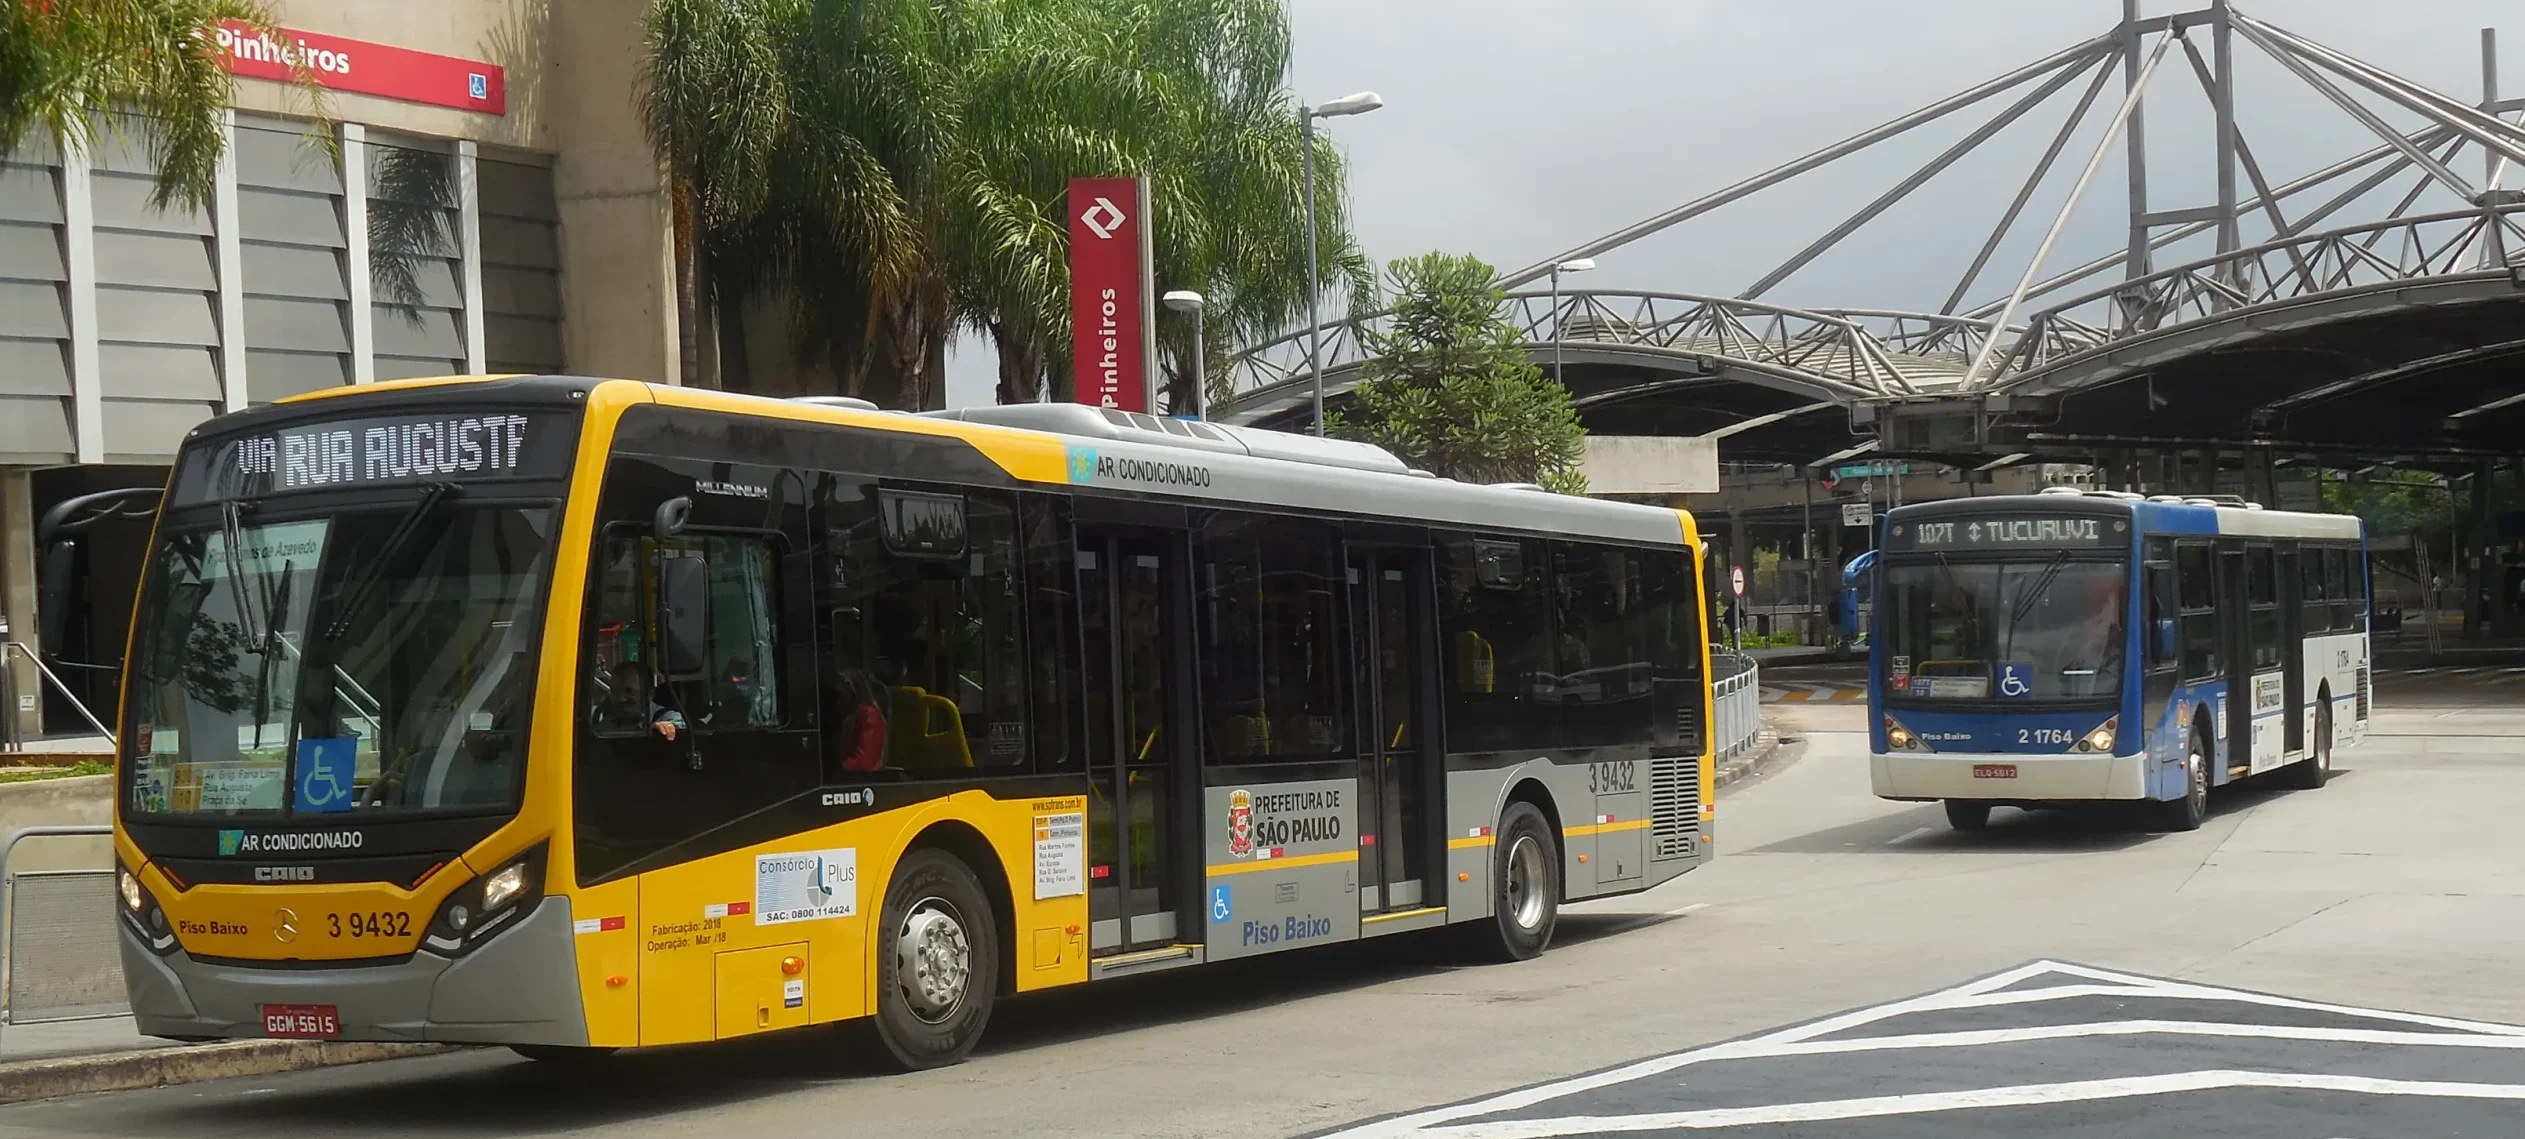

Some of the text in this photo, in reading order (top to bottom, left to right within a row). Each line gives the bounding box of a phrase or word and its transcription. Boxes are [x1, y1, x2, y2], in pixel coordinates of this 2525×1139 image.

[215, 27, 350, 75] Pinheiros
[1098, 287, 1118, 408] Pinheiros
[285, 431, 354, 486] RUA
[1097, 456, 1211, 488] AR CONDICIONADO
[1918, 519, 2099, 544] 107T TUCURUVI
[2018, 729, 2073, 744] 2 1764
[1589, 761, 1634, 793] 3 9432
[821, 791, 862, 806] CAIO
[1032, 797, 1082, 813] www.sptrans.com.br
[1255, 790, 1341, 814] PREFEITURA DE
[241, 831, 363, 851] AR CONDICIONADO
[1256, 816, 1341, 848] SÃO PAULO
[254, 866, 315, 881] CAIO
[759, 857, 855, 883] Consórcio Plus
[327, 911, 412, 938] 3 9432
[766, 904, 850, 923] SAC: 0800 114424
[179, 920, 248, 936] Piso Baixo
[652, 918, 722, 937] Fabricação: 2018
[1243, 914, 1331, 947] Piso Baixo
[647, 938, 691, 953] Operação:
[696, 935, 711, 946] Mar
